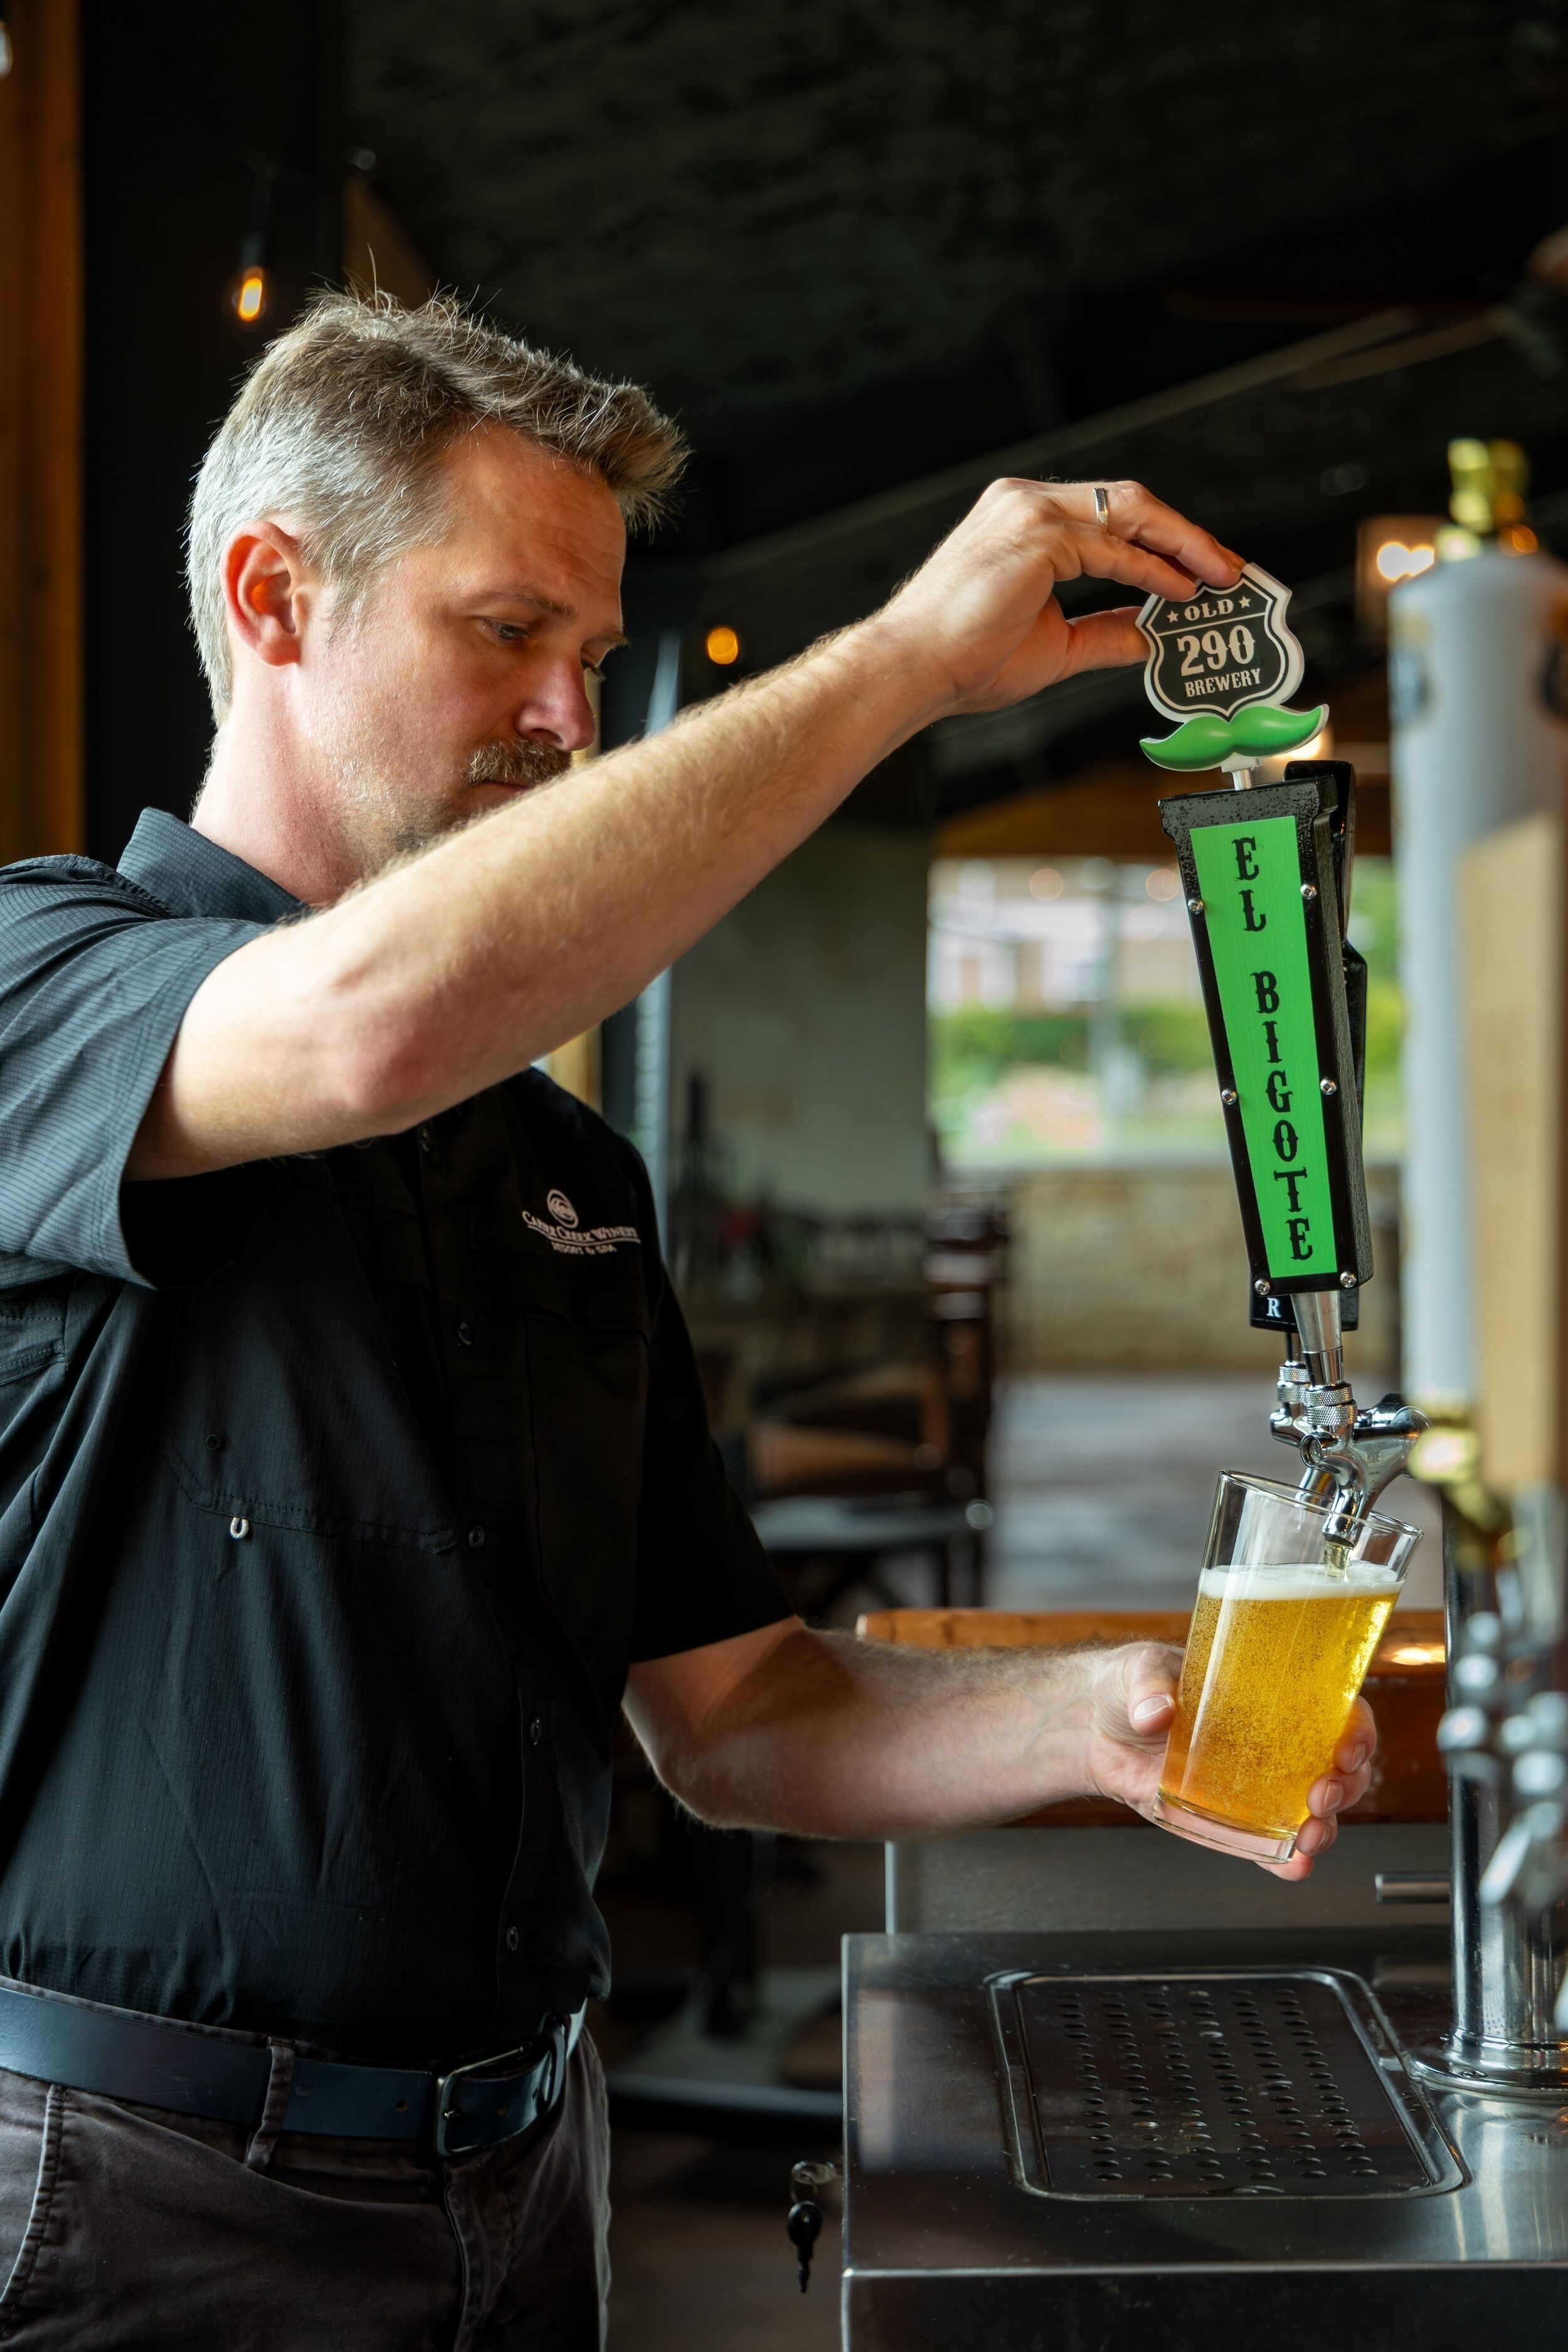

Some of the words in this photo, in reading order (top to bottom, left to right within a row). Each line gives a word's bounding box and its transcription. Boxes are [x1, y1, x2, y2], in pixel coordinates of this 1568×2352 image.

[1184, 598, 1234, 621] OLD
[1177, 625, 1256, 677] 290
[1184, 668, 1261, 697] BREWERY
[1232, 837, 1266, 932] EL
[1251, 971, 1313, 1261] BIGOTE
[556, 1226, 595, 1243] CREEK
